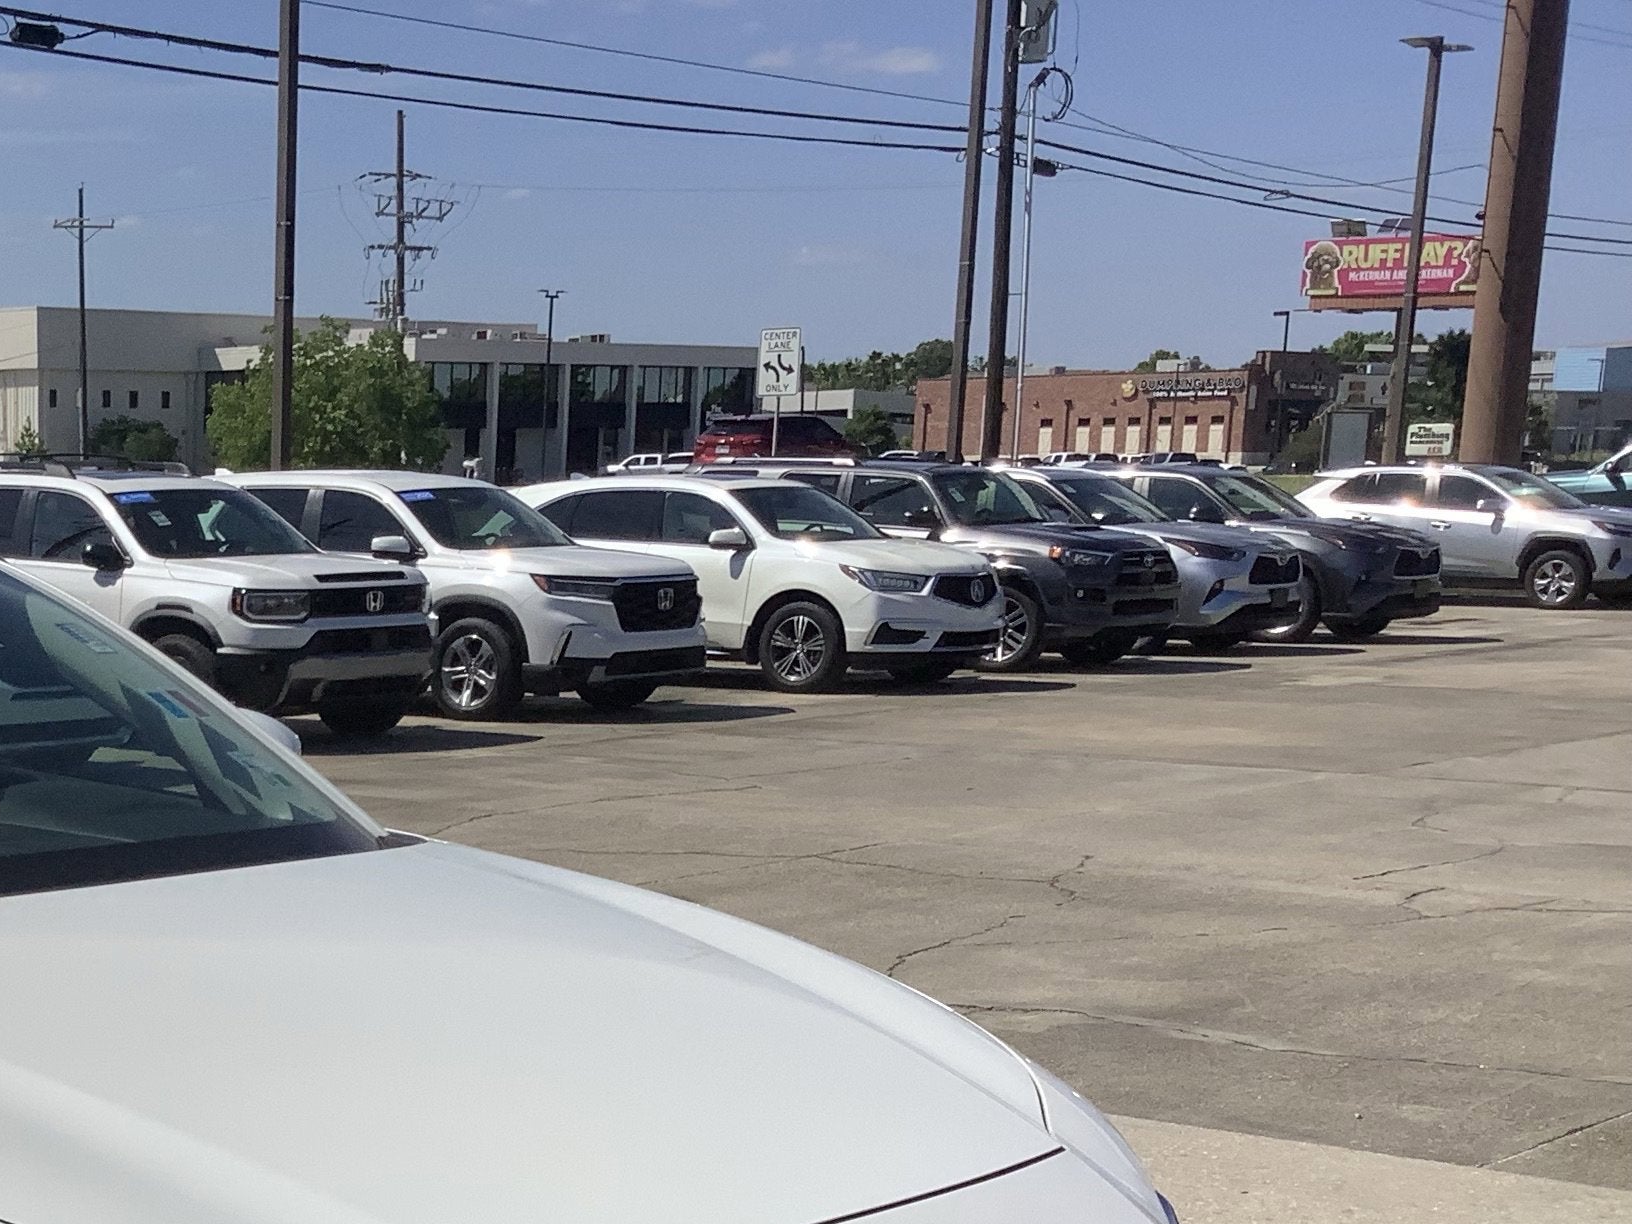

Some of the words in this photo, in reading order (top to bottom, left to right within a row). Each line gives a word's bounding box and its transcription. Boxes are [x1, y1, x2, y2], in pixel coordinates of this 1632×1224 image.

[1342, 242, 1402, 268] RUFF
[764, 331, 798, 341] CENTER
[768, 341, 791, 350] LANE
[1218, 377, 1243, 387] BAO
[765, 383, 789, 393] ONLY
